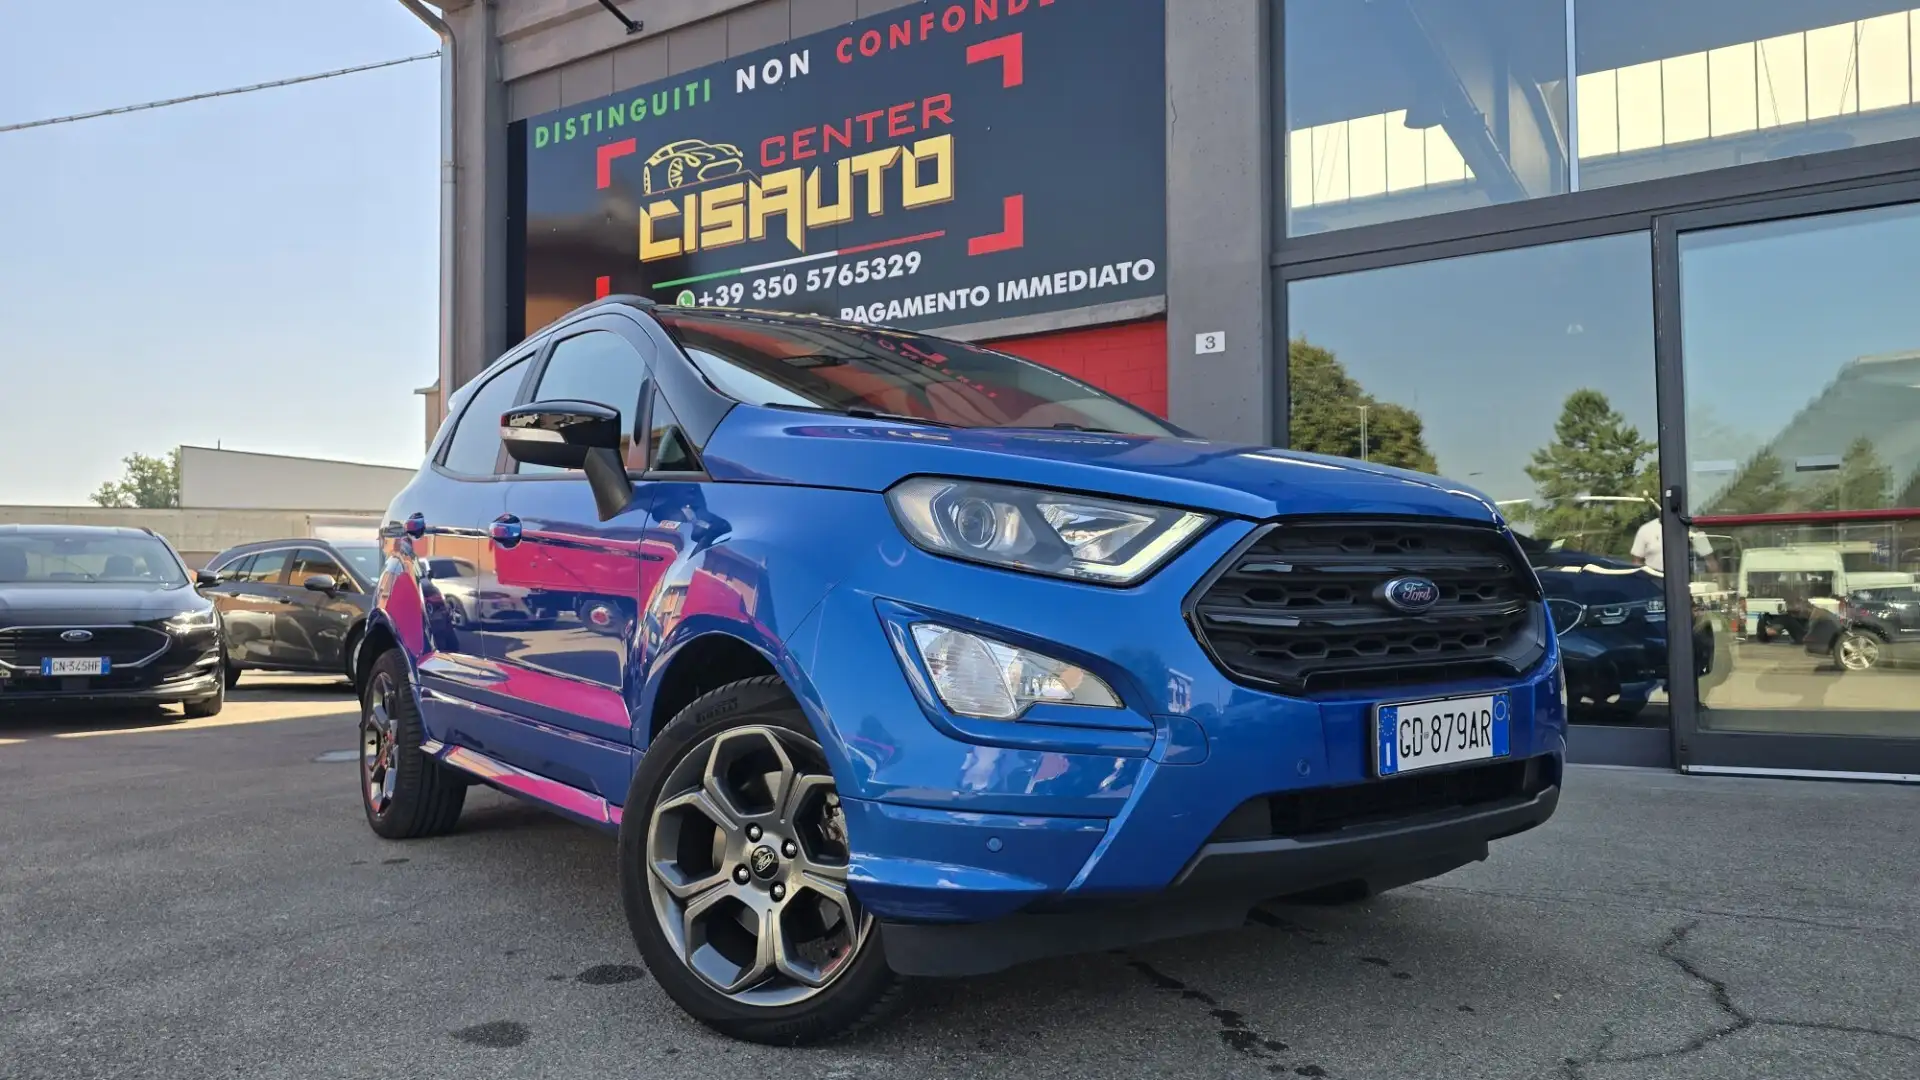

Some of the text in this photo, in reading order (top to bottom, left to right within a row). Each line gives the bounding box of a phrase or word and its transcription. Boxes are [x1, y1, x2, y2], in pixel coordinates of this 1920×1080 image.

[535, 0, 1053, 149] DISTINGUITI NON CONFOND
[760, 93, 954, 167] CENTER
[639, 133, 954, 263] CISAUTO
[698, 250, 922, 307] +39 350 5765329
[840, 258, 1156, 325] PAGAMENTO IMMEDIATO
[1205, 335, 1216, 350] 3
[1402, 582, 1432, 601] Ford
